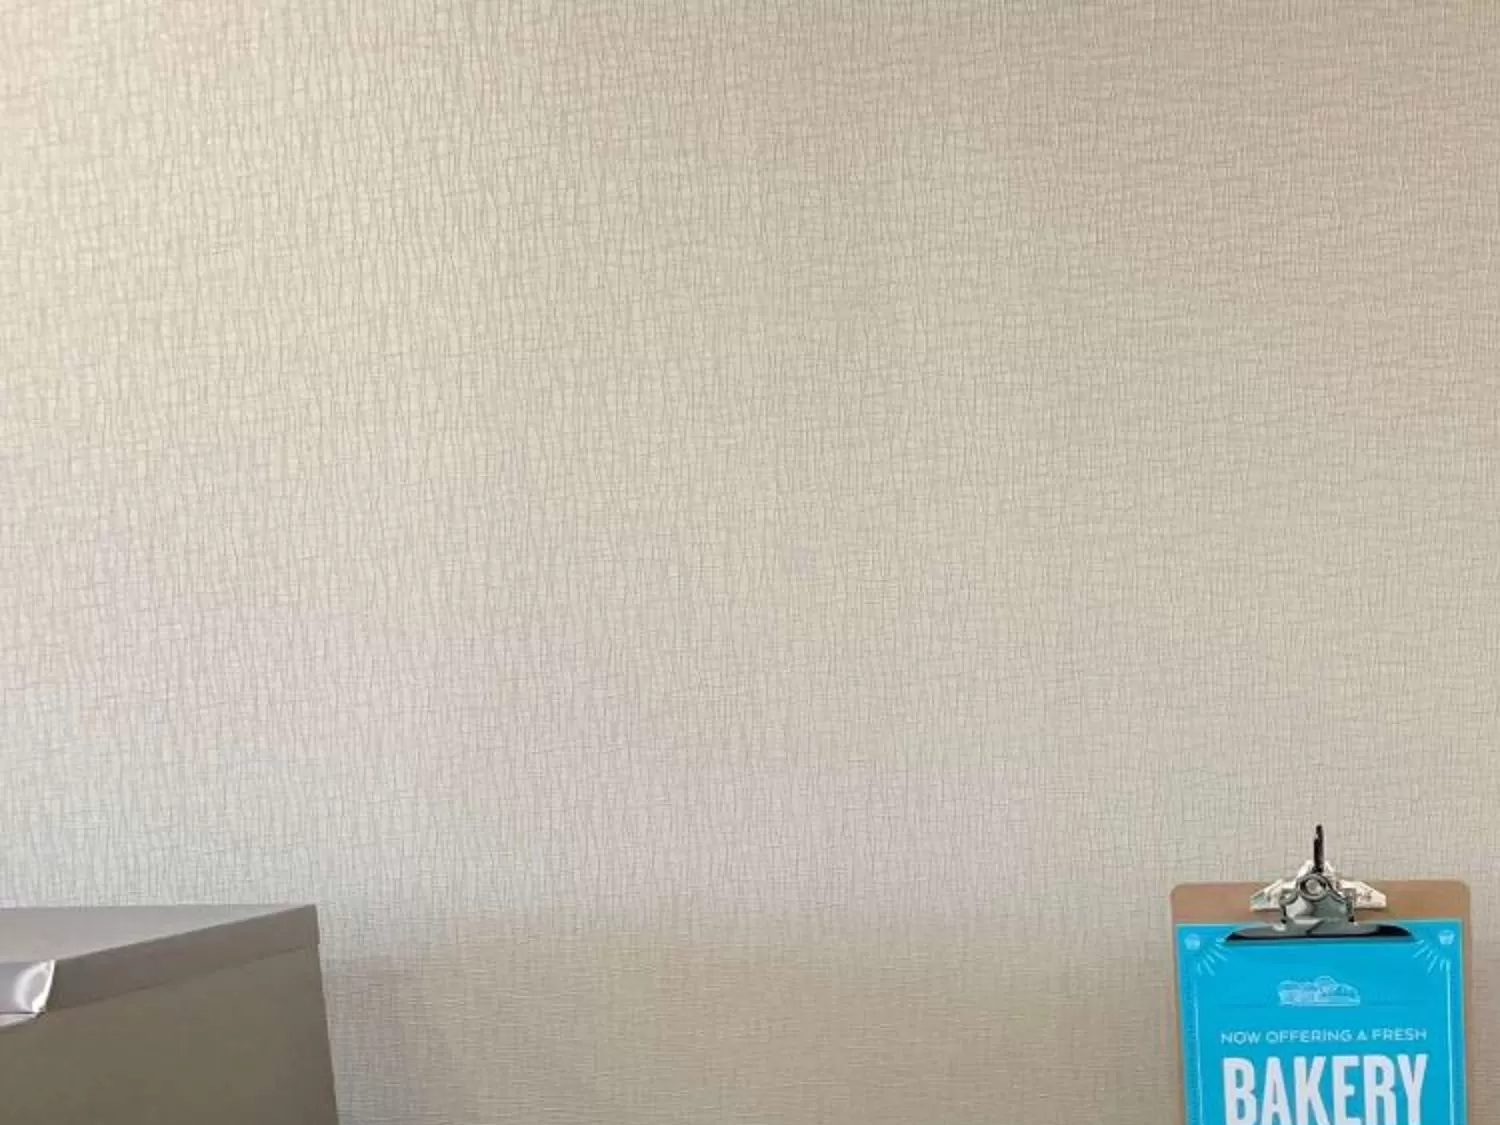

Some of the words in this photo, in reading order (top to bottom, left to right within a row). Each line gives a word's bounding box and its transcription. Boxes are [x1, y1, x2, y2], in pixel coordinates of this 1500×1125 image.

[1221, 1031, 1261, 1045] NOW
[1265, 1029, 1353, 1044] OFFERING
[1356, 1029, 1368, 1041] A
[1372, 1028, 1427, 1041] FRESH
